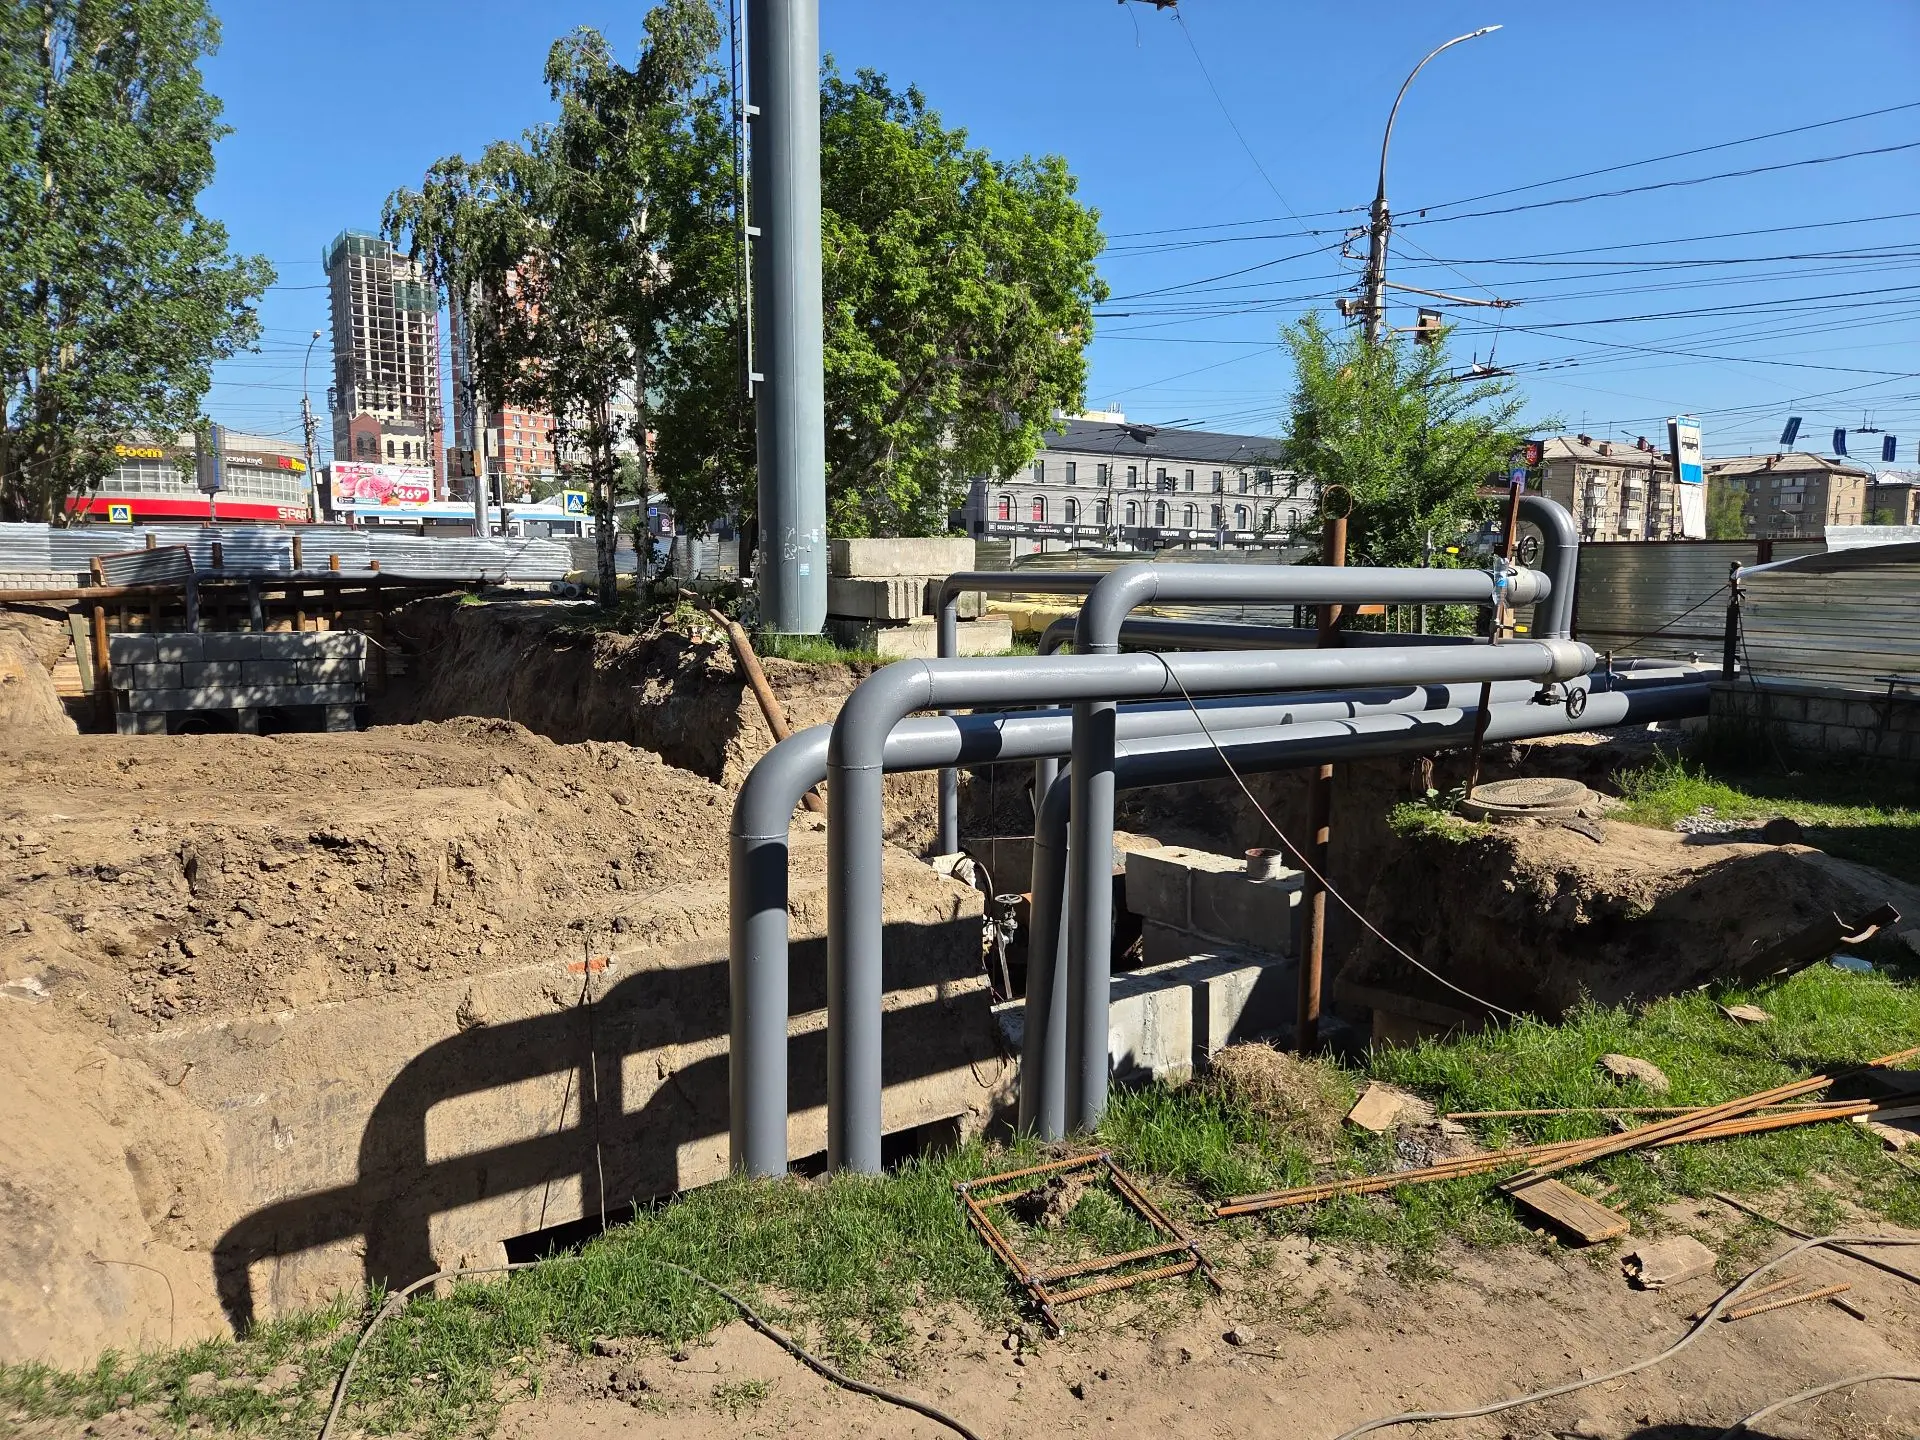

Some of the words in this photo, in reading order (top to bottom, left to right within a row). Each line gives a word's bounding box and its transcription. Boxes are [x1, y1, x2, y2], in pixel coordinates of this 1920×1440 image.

[247, 458, 263, 466] клуб
[344, 466, 373, 474] SPAR
[277, 507, 307, 520] SPAR
[1078, 527, 1100, 535] АПТЕКА
